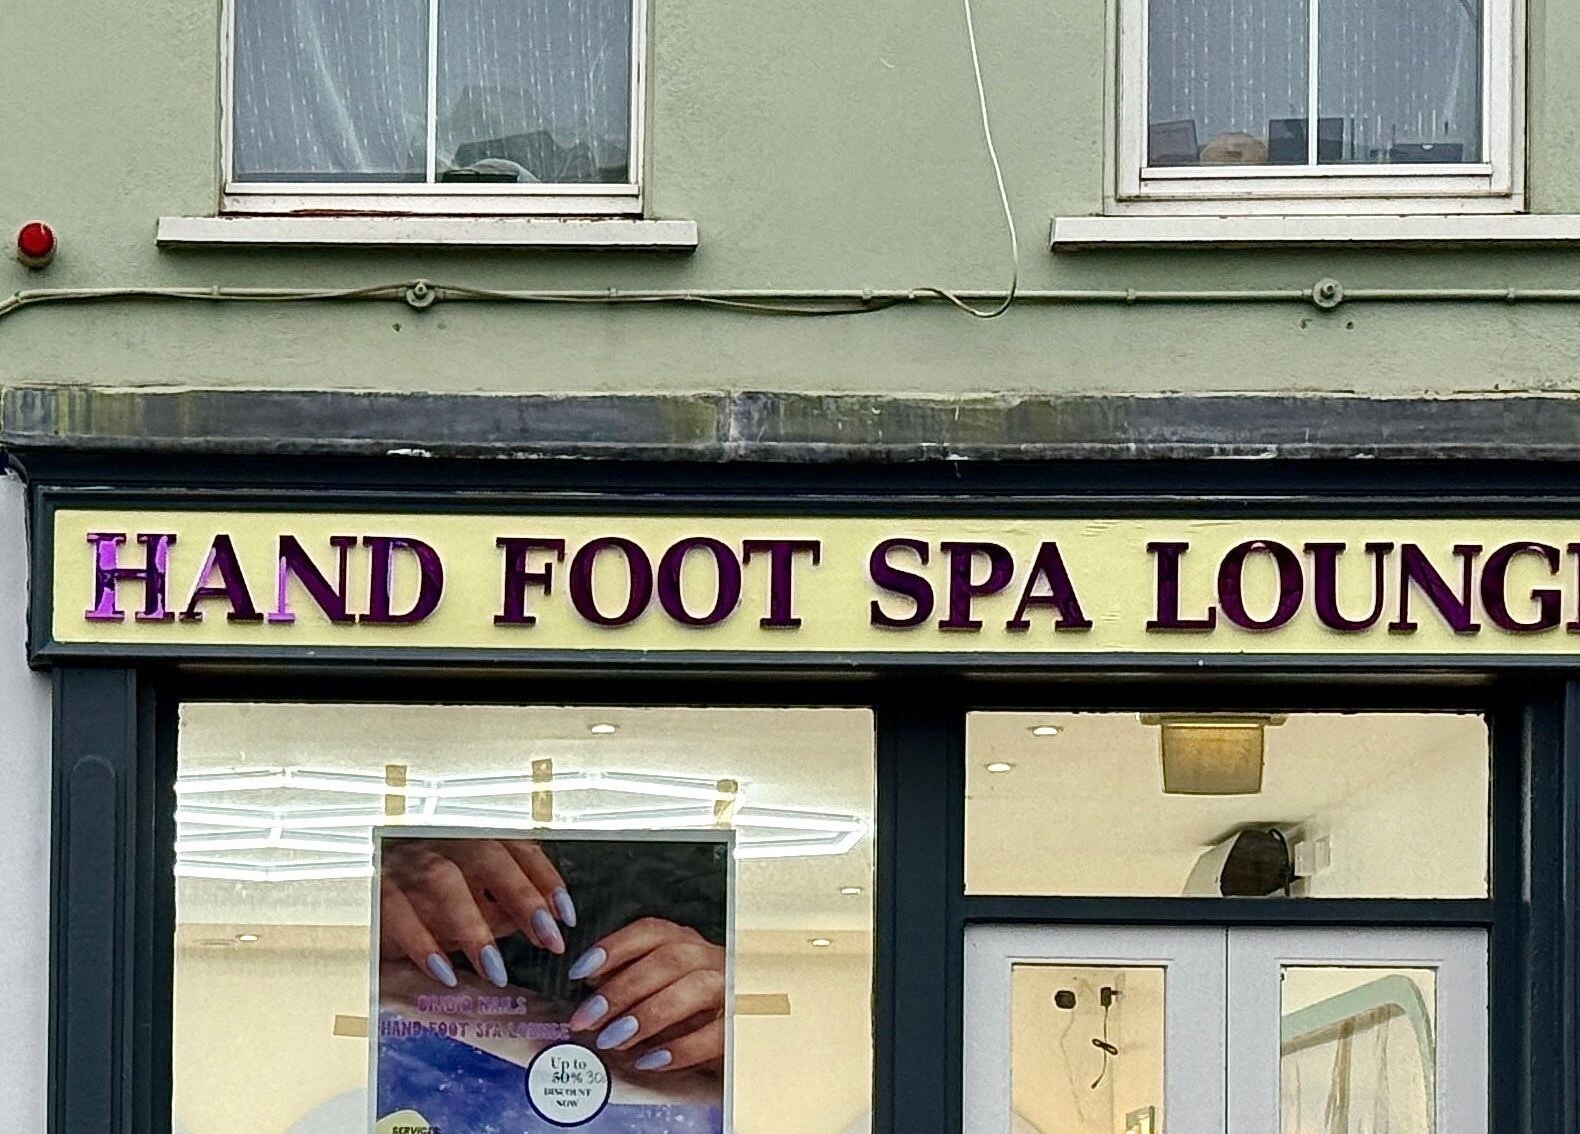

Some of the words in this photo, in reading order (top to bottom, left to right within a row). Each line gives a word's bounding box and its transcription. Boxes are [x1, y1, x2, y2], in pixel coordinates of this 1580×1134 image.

[86, 533, 444, 627] HAND
[494, 537, 820, 630] FOOT
[870, 539, 1092, 633] SPA
[380, 1020, 421, 1037] HAND
[429, 1022, 469, 1038] FOOT
[476, 1022, 502, 1038] SPA
[508, 1022, 571, 1040] LOUNGE
[551, 1057, 570, 1073] Up
[574, 1059, 587, 1070] to
[544, 1087, 591, 1097] DISCOUNT
[556, 1099, 578, 1107] NOW
